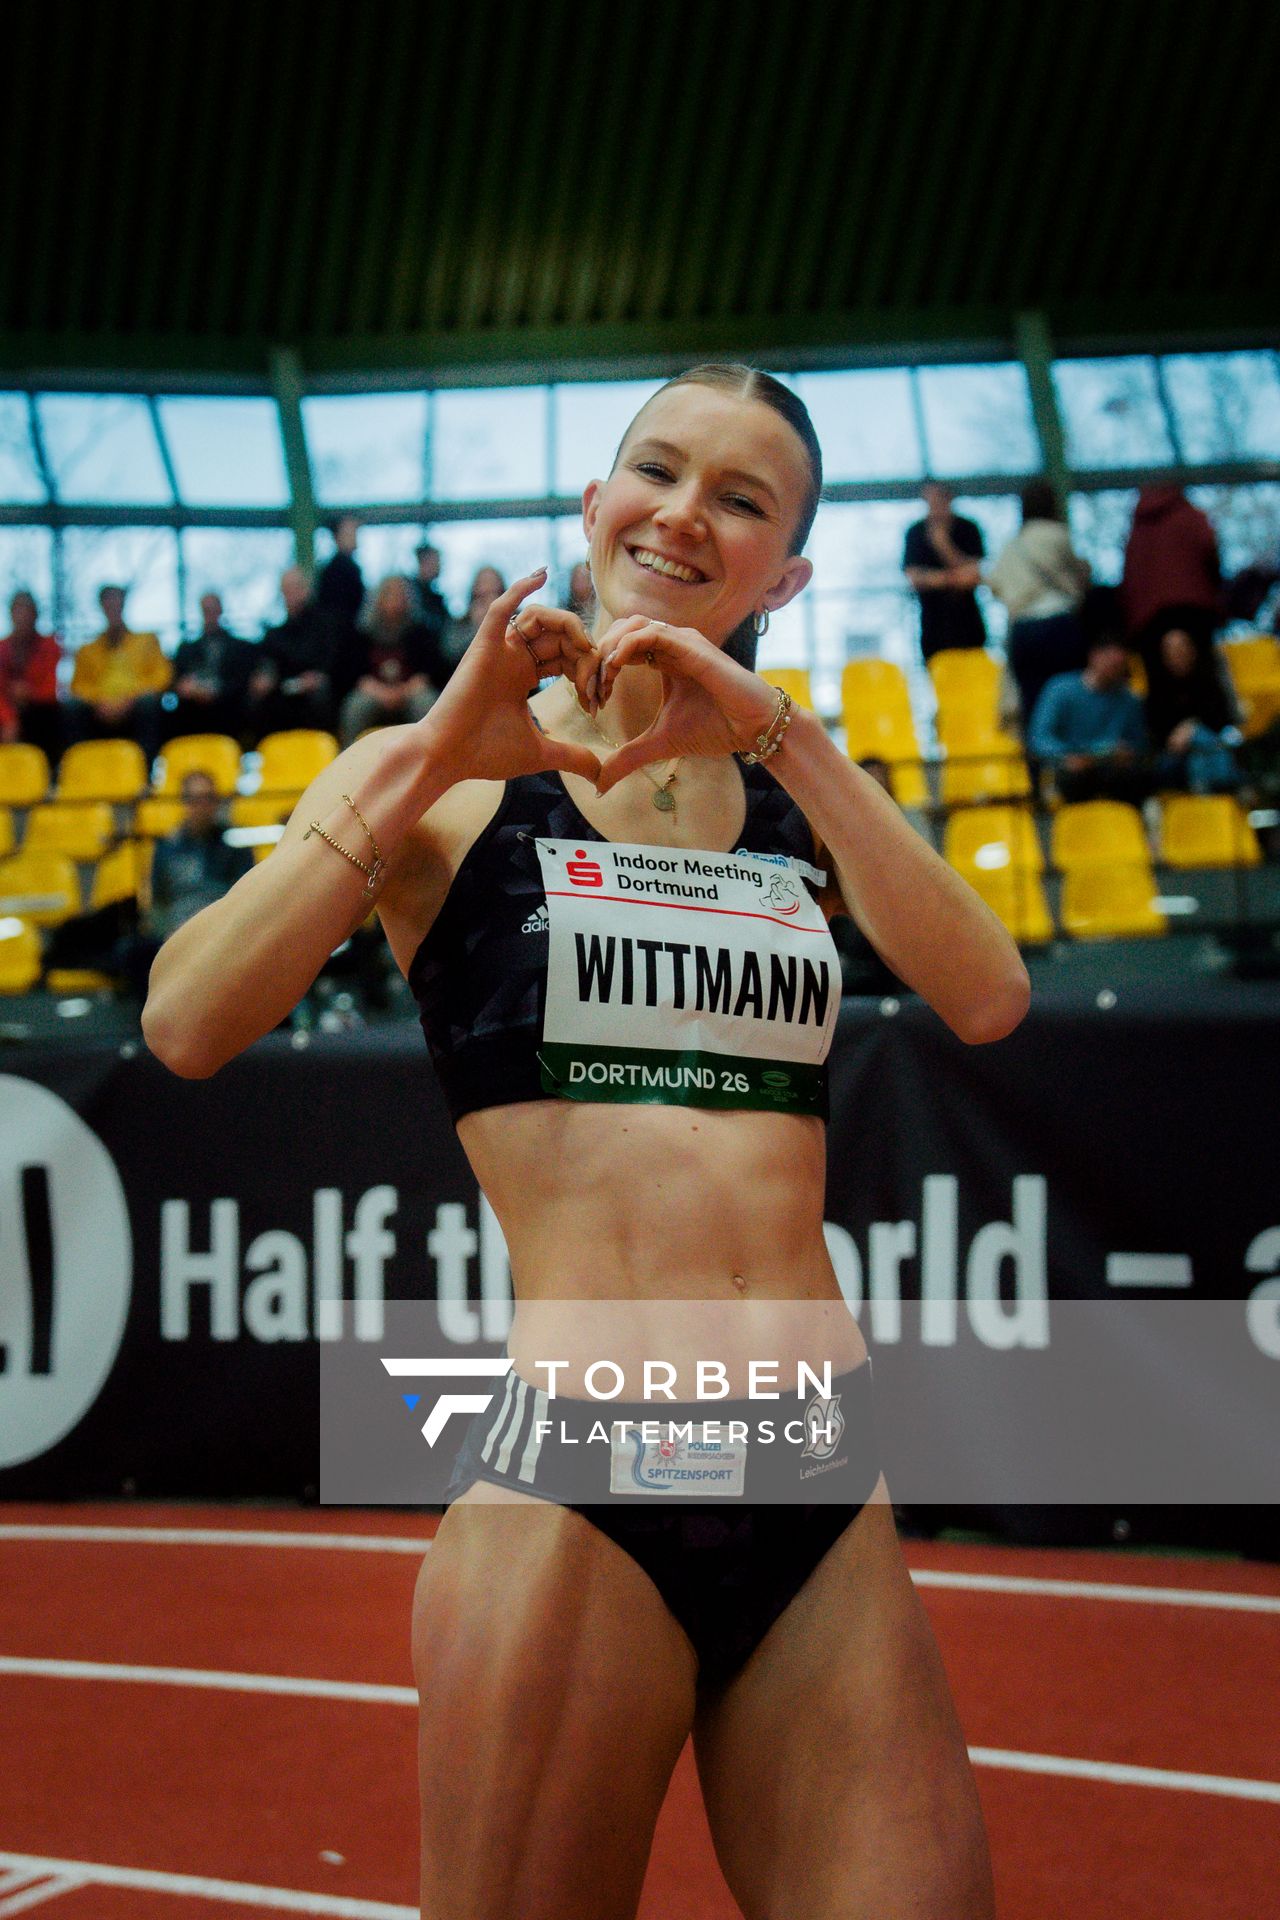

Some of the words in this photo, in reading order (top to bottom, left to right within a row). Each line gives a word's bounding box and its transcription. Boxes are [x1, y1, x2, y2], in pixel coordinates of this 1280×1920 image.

[612, 851, 679, 874] Indoor
[684, 858, 763, 888] Meeting
[617, 873, 719, 900] Dortmund
[521, 918, 550, 934] adi
[574, 932, 830, 1028] WITTMANN
[568, 1061, 716, 1089] DORTMUND
[719, 1070, 751, 1093] 26
[159, 1184, 399, 1342] Half
[647, 1468, 734, 1481] SPITZENSPORT
